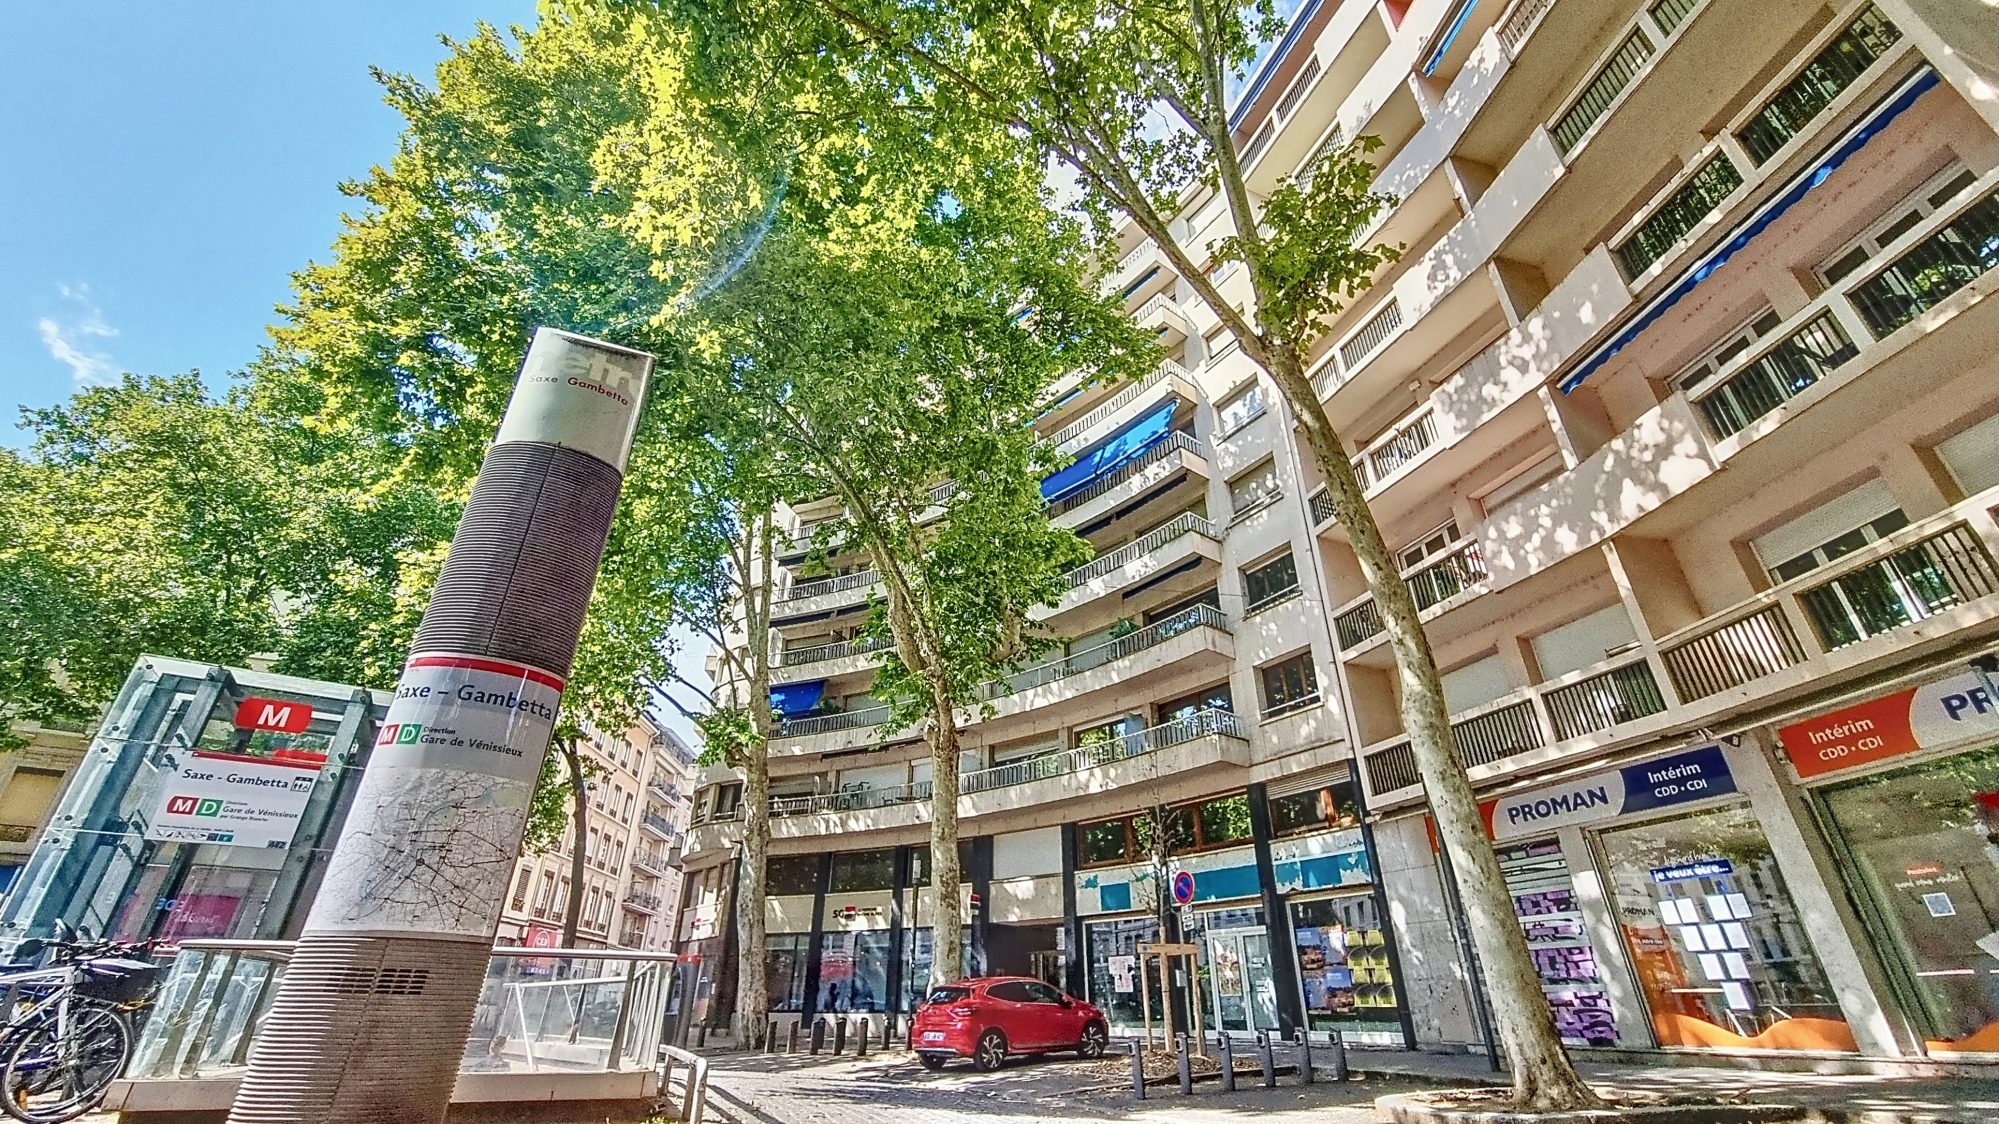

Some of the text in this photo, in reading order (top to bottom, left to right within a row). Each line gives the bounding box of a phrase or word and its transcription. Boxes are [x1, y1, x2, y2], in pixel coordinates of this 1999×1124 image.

[528, 374, 628, 406] Saxe Gambetta
[457, 684, 552, 721] Gambetta
[1940, 686, 1999, 721] PR
[257, 704, 292, 728] M
[401, 726, 416, 742] D
[423, 726, 456, 735] Direction
[1808, 718, 1875, 745] Intérim
[420, 734, 523, 757] Gare de Vénissieux
[1818, 745, 1849, 761] CDD
[1857, 735, 1884, 751] CDI
[182, 768, 214, 781] Saxe
[226, 773, 289, 789] Gambetta
[1647, 761, 1702, 784] Intérim
[1654, 785, 1679, 798] CDD
[1686, 778, 1708, 792] CDI
[172, 799, 217, 814] M D
[222, 806, 299, 819] Gare de Vénissieux
[1507, 786, 1610, 825] PROMAN
[1653, 870, 1665, 882] je
[1665, 868, 1694, 879] veux
